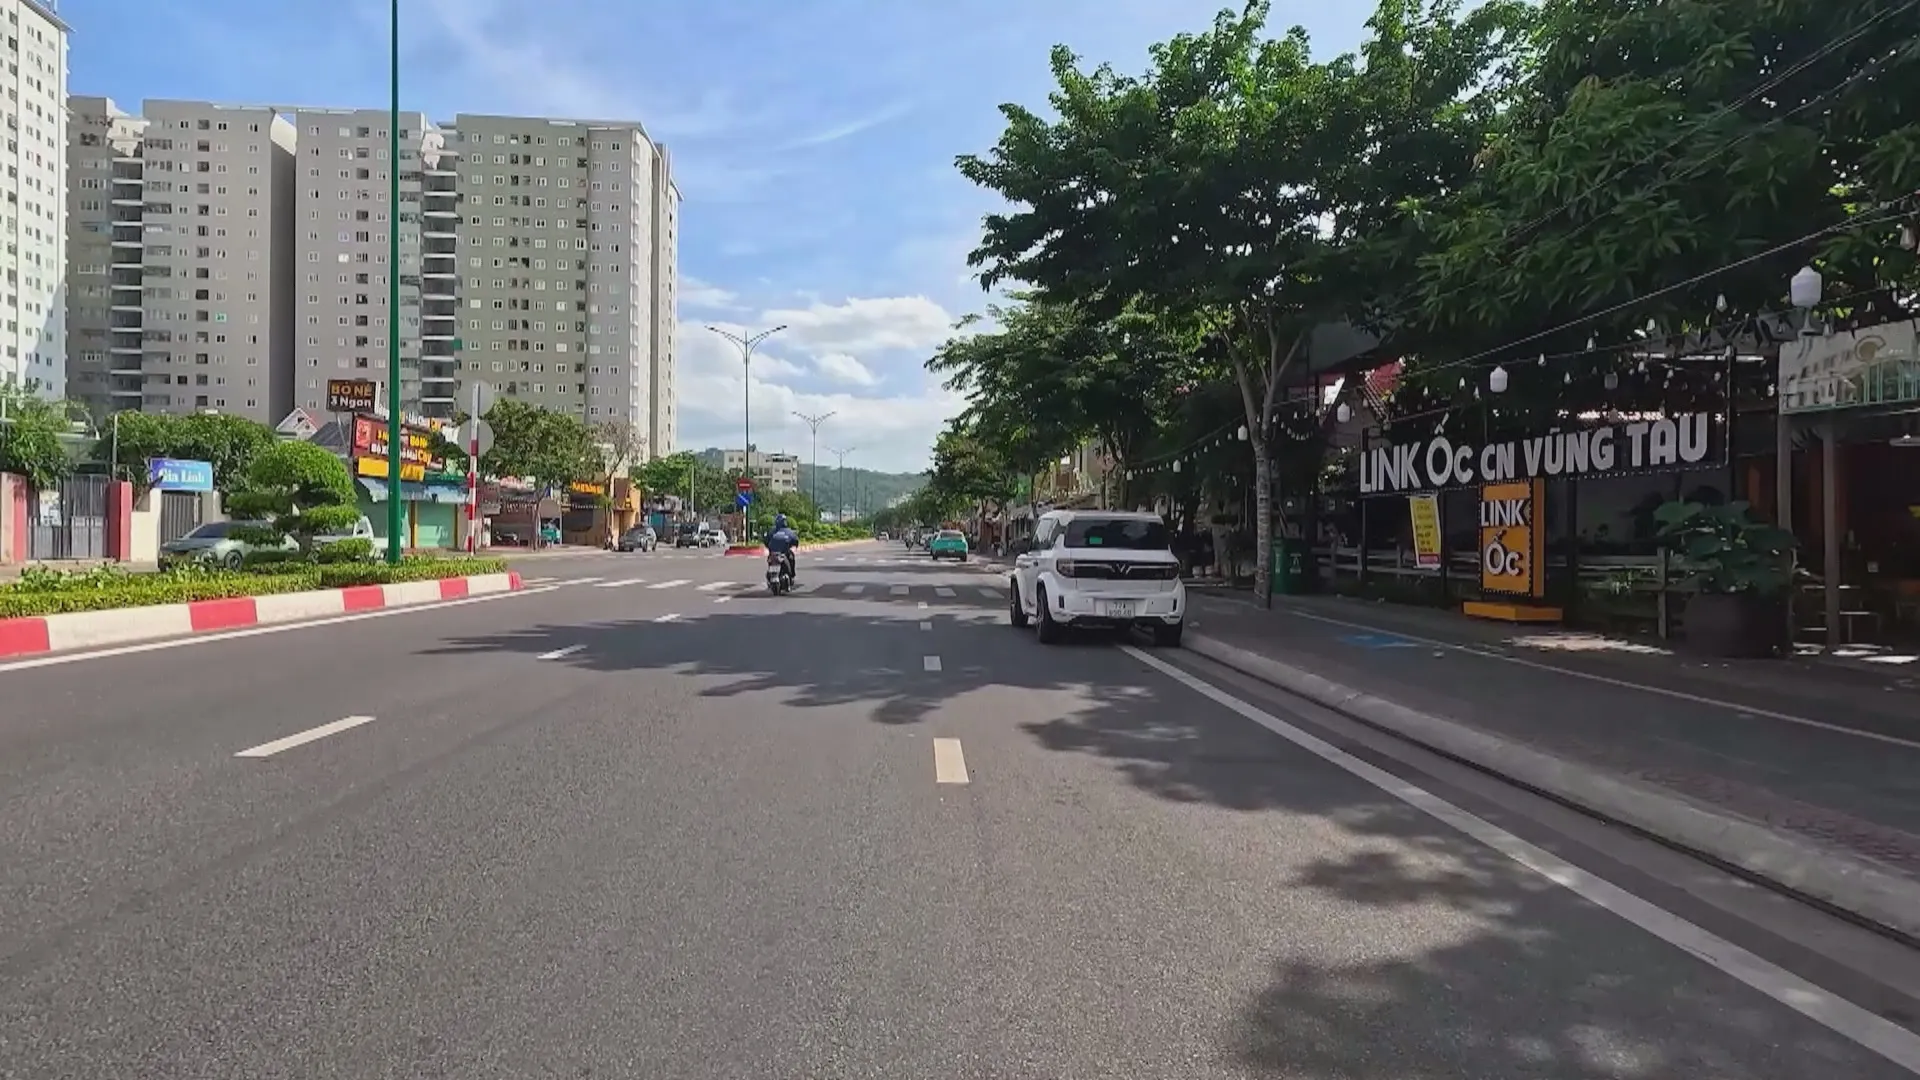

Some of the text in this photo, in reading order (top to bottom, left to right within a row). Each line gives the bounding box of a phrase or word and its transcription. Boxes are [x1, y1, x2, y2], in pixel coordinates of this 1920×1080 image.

[331, 395, 371, 409] 3 Ngon
[1360, 440, 1422, 493] LINK
[1480, 442, 1515, 481] CN
[1523, 427, 1615, 476] VŨNG
[1481, 499, 1525, 527] LINK
[1486, 530, 1520, 576] Ốc
